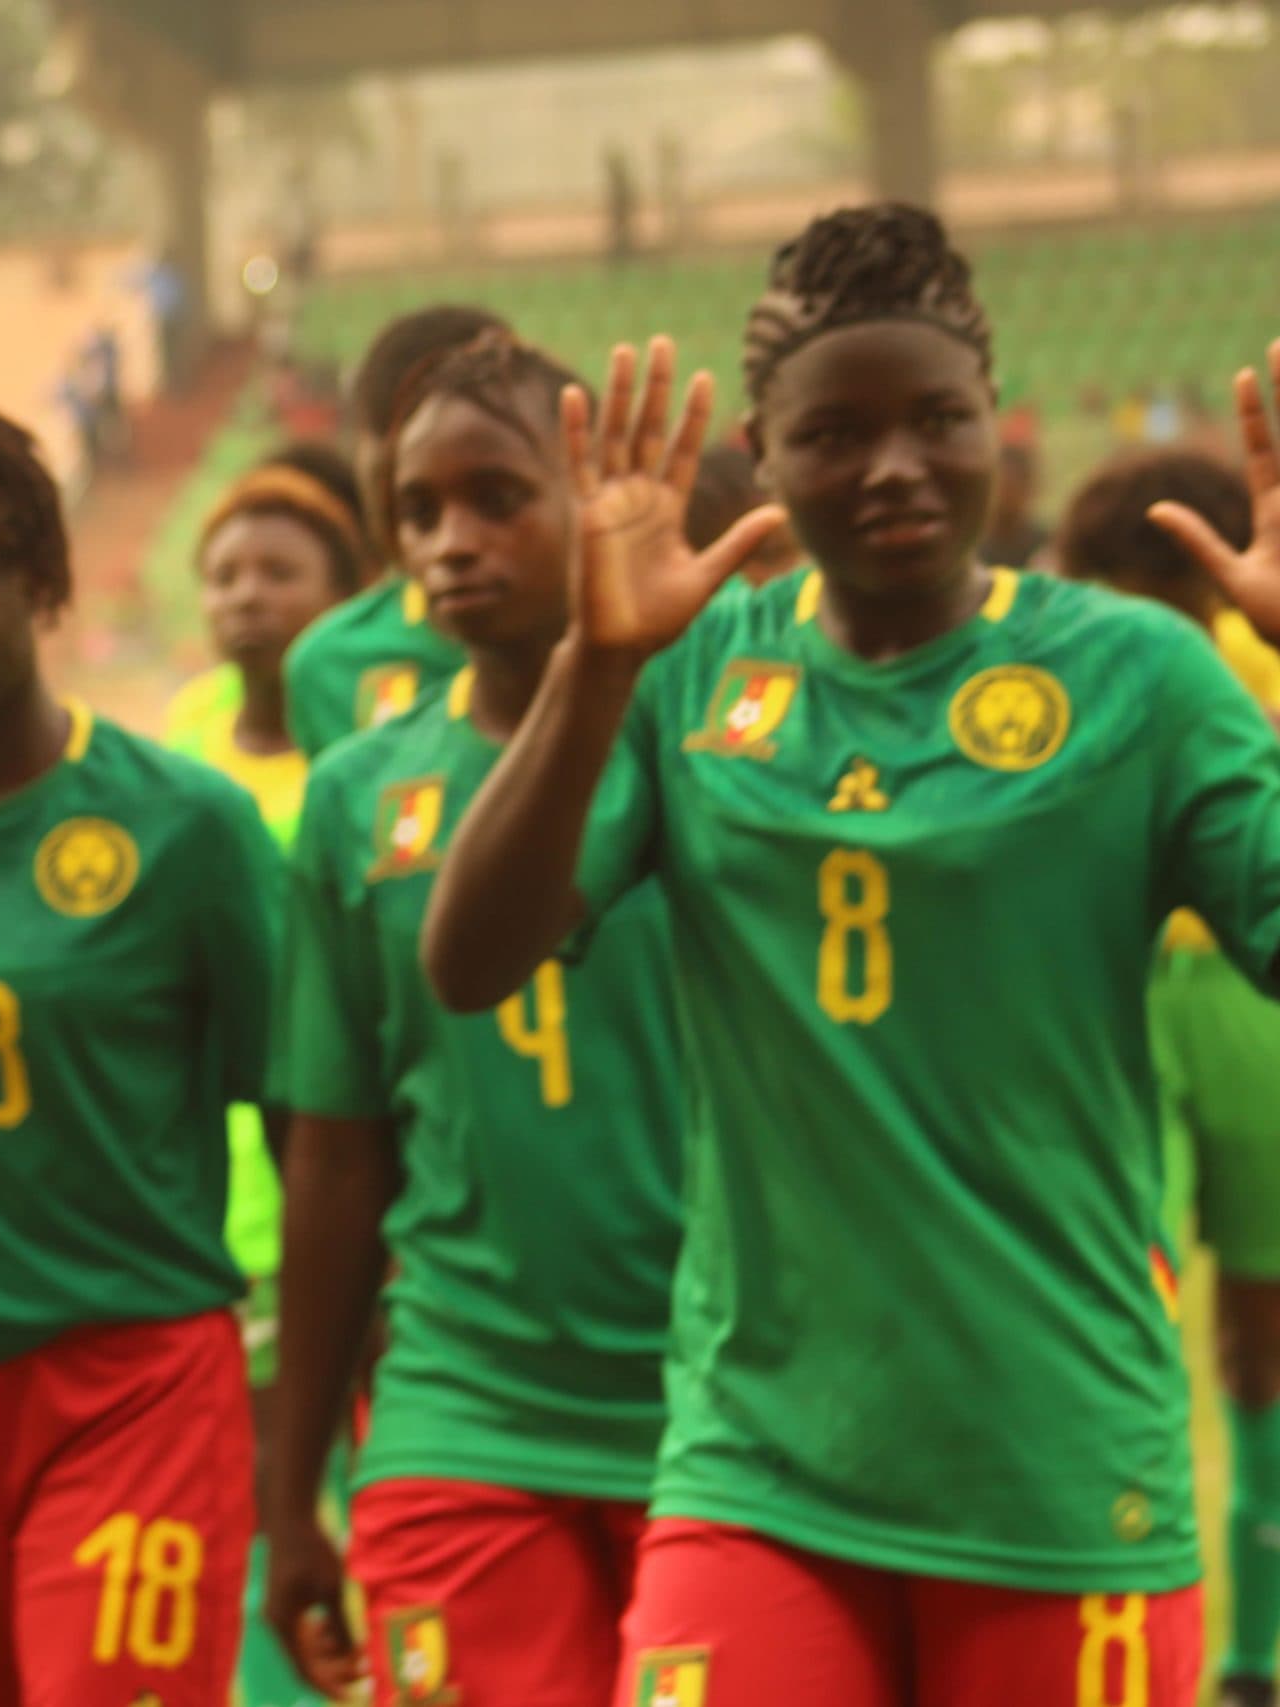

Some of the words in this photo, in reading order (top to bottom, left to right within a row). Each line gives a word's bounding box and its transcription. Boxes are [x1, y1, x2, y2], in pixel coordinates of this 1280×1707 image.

[816, 849, 892, 1025] 8
[497, 959, 571, 1107] 4
[73, 1512, 202, 1667] 18
